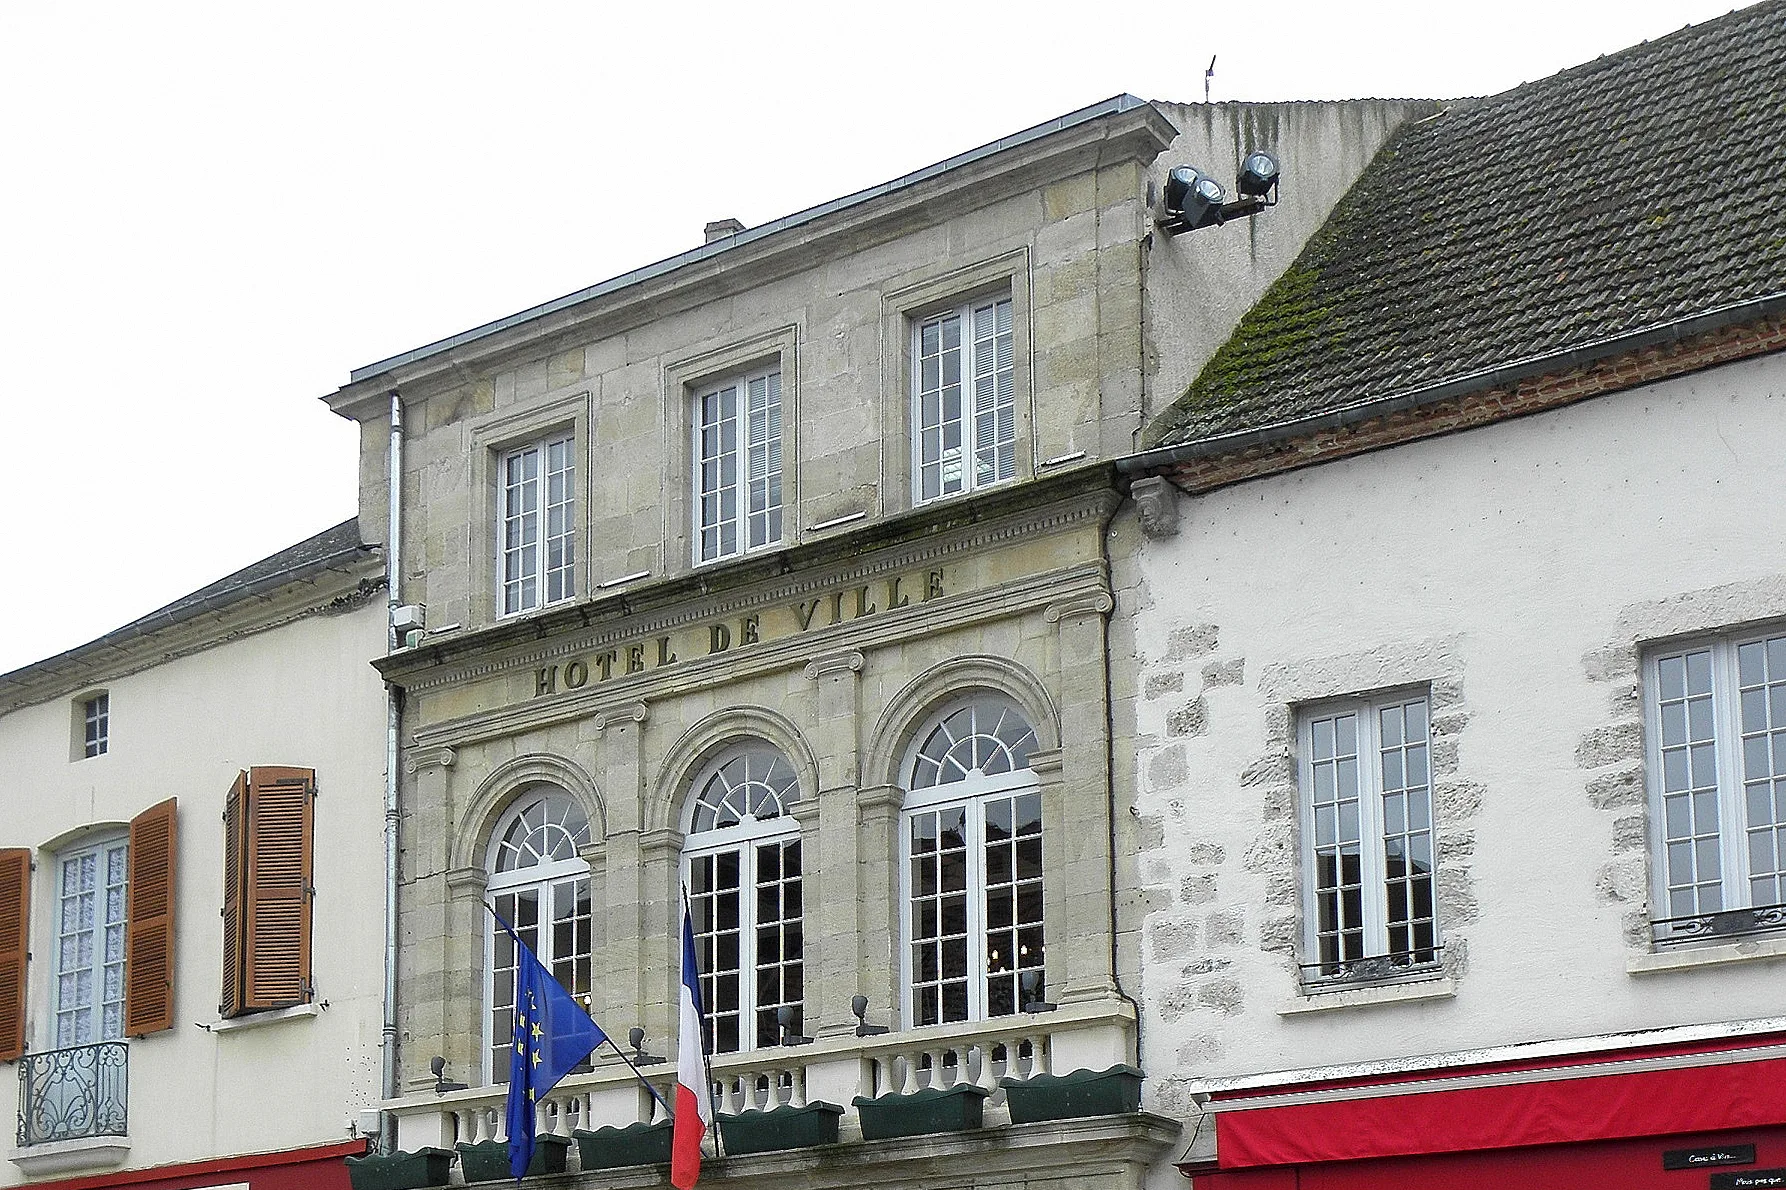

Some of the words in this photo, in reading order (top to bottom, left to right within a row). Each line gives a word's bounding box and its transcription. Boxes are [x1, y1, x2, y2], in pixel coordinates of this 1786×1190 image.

[533, 636, 678, 698] HOTEL
[708, 614, 760, 655] DE
[789, 567, 945, 631] VILLE
[1688, 1154, 1709, 1162] Cave
